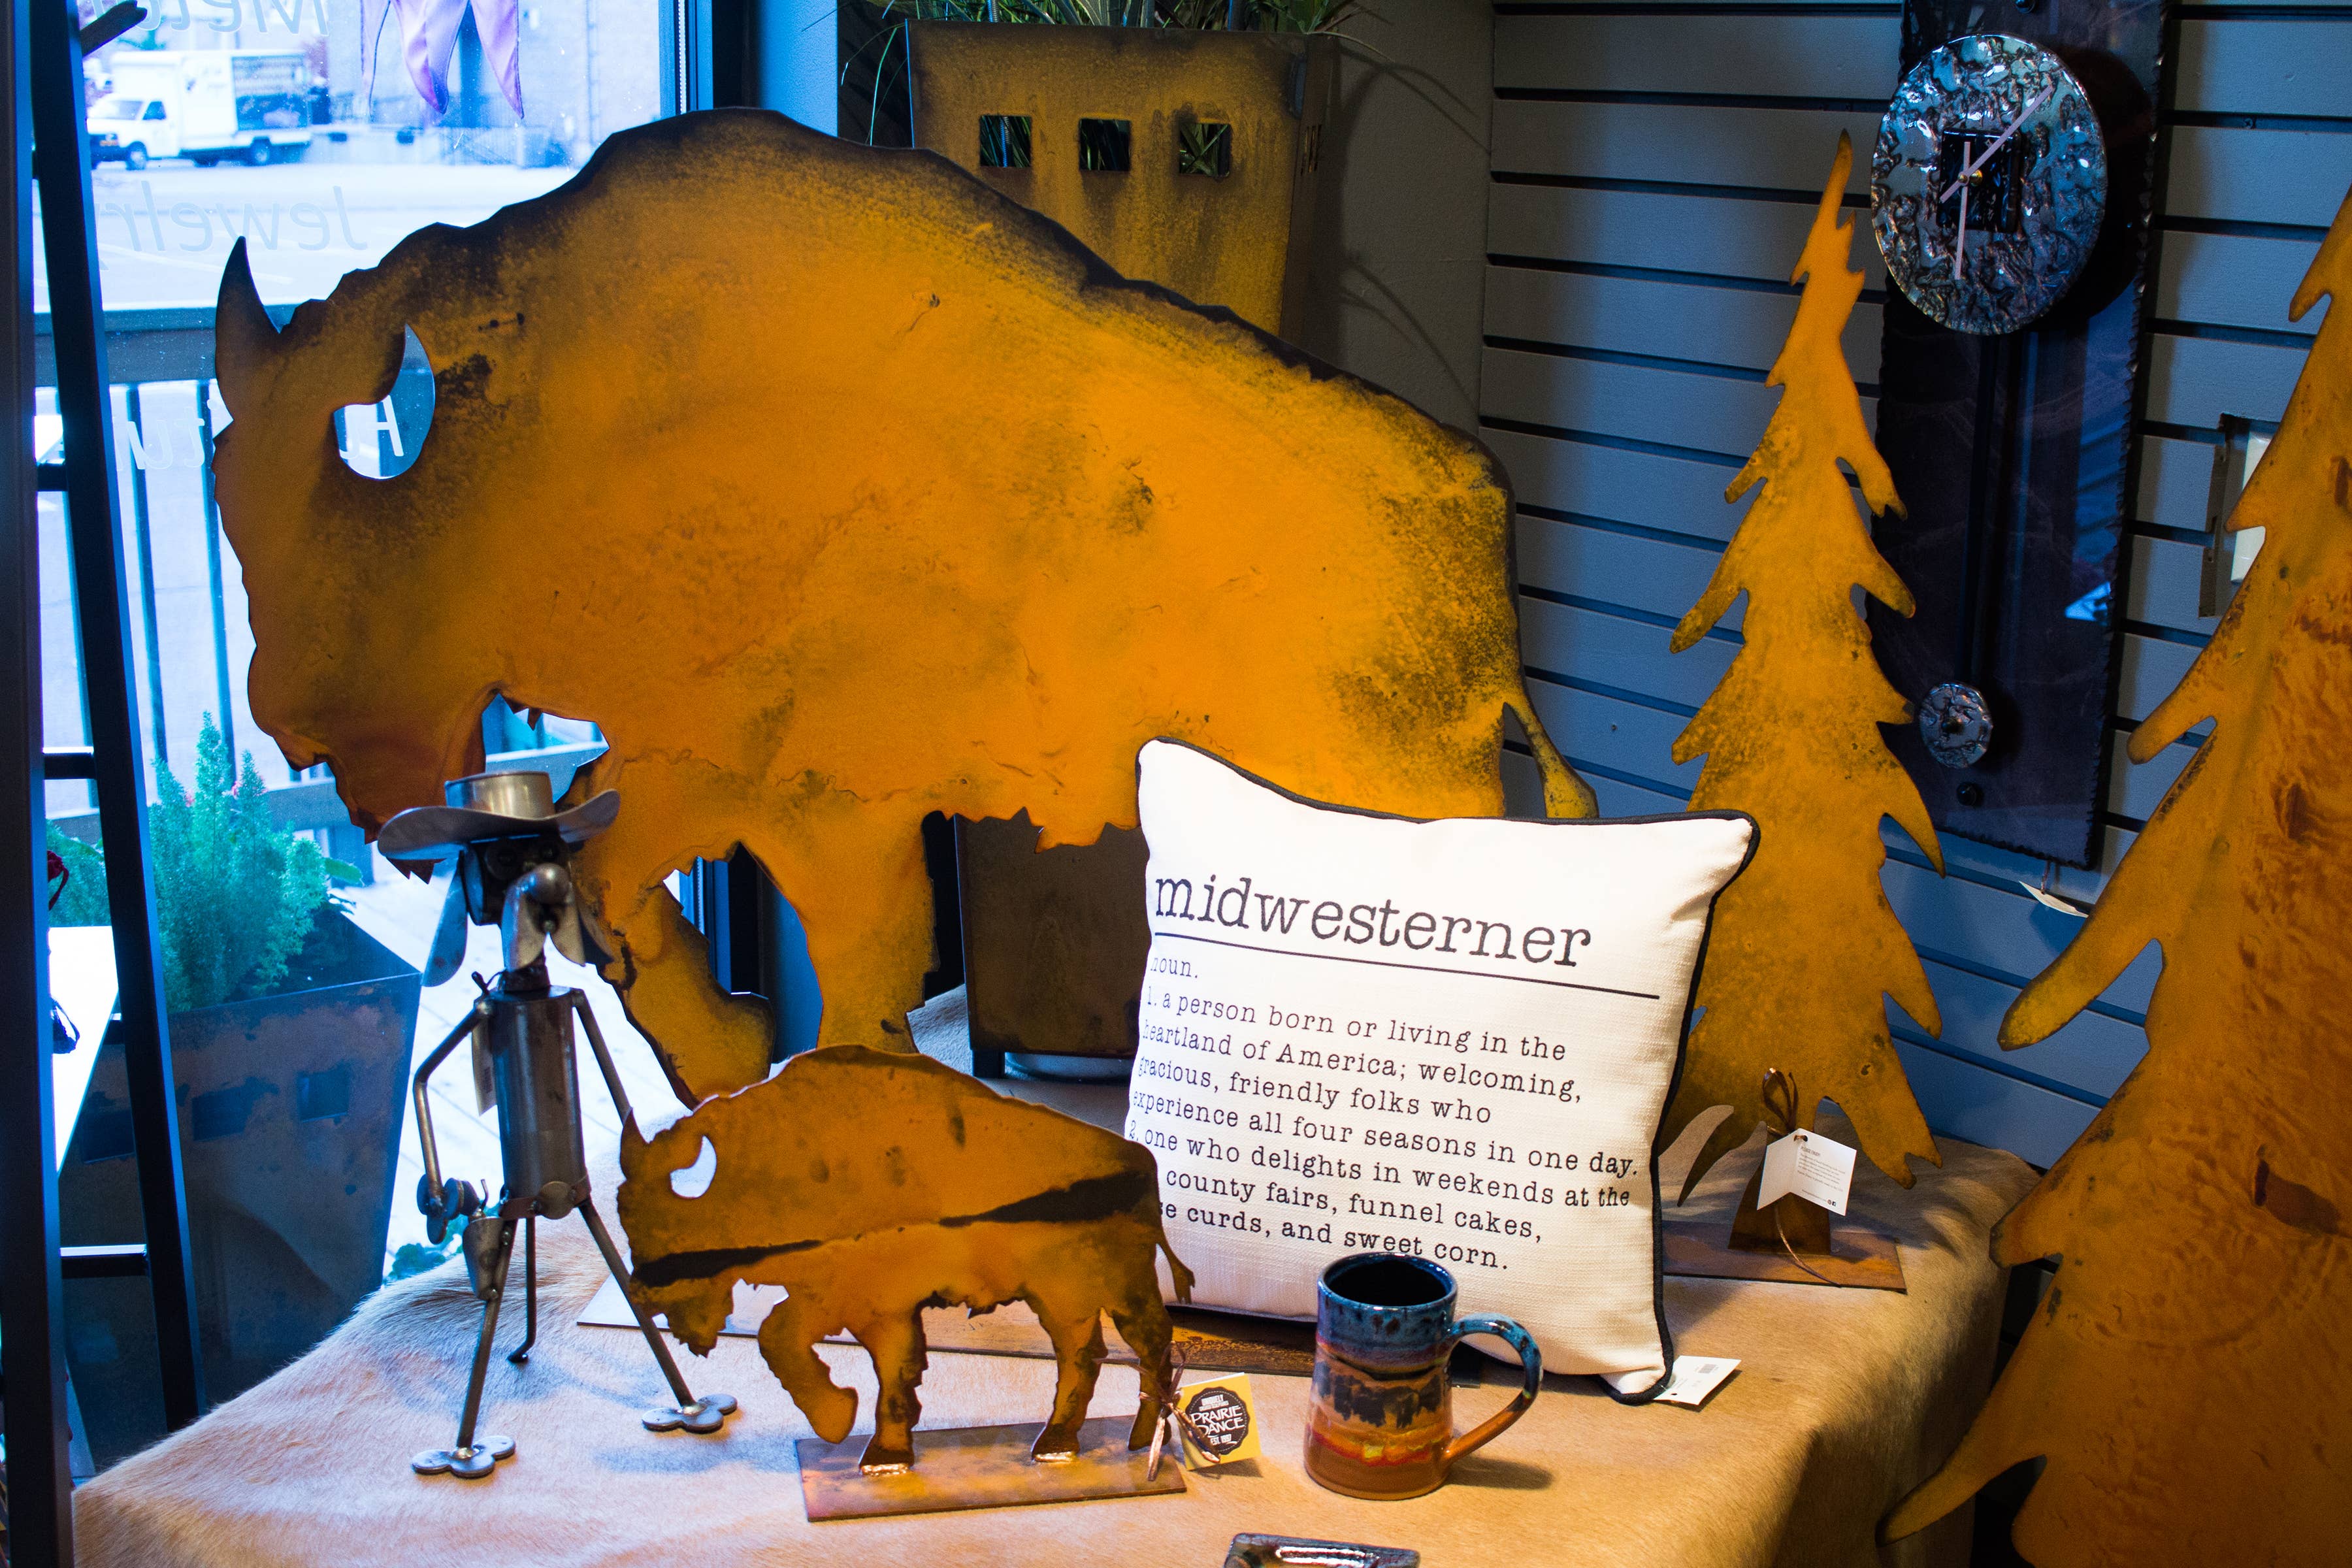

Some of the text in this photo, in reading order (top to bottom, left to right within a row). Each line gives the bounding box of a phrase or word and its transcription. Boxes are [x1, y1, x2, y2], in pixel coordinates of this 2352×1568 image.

[1156, 874, 1591, 967] midwesterner
[1151, 958, 1198, 978] noun.
[1162, 993, 1171, 1009] a
[1176, 996, 1256, 1023] person
[1269, 1005, 1333, 1033] born
[1347, 1021, 1377, 1037] or
[1387, 1020, 1471, 1053] living
[1480, 1032, 1508, 1054] in
[1521, 1036, 1565, 1060] the
[1229, 1071, 1340, 1110] friendly
[1350, 1087, 1419, 1115] folks
[1430, 1098, 1491, 1123] who
[1243, 1040, 1271, 1060] of
[1275, 1043, 1405, 1081] America;
[1418, 1063, 1580, 1103] welcoming,
[1145, 1129, 1177, 1151] one
[1186, 1137, 1239, 1162] who
[1252, 1146, 1361, 1180] delights
[1373, 1162, 1401, 1183] in
[1412, 1170, 1553, 1204] weekends
[1565, 1188, 1589, 1207] at
[1598, 1186, 1630, 1207] the
[1249, 1112, 1282, 1134] all
[1292, 1116, 1352, 1143] four
[1364, 1130, 1476, 1157] seasons
[1488, 1141, 1516, 1163] in
[1528, 1151, 1578, 1170] one
[1589, 1151, 1637, 1179] day.
[1167, 1170, 1541, 1243] county fairs, funnel cakes,
[1187, 1207, 1270, 1238] curds,
[1282, 1222, 1332, 1244] and
[1344, 1232, 1422, 1255] sweet
[1434, 1243, 1507, 1269] corn.
[1190, 1405, 1243, 1424] PRAIRIE
[1196, 1417, 1245, 1437] DANCE
